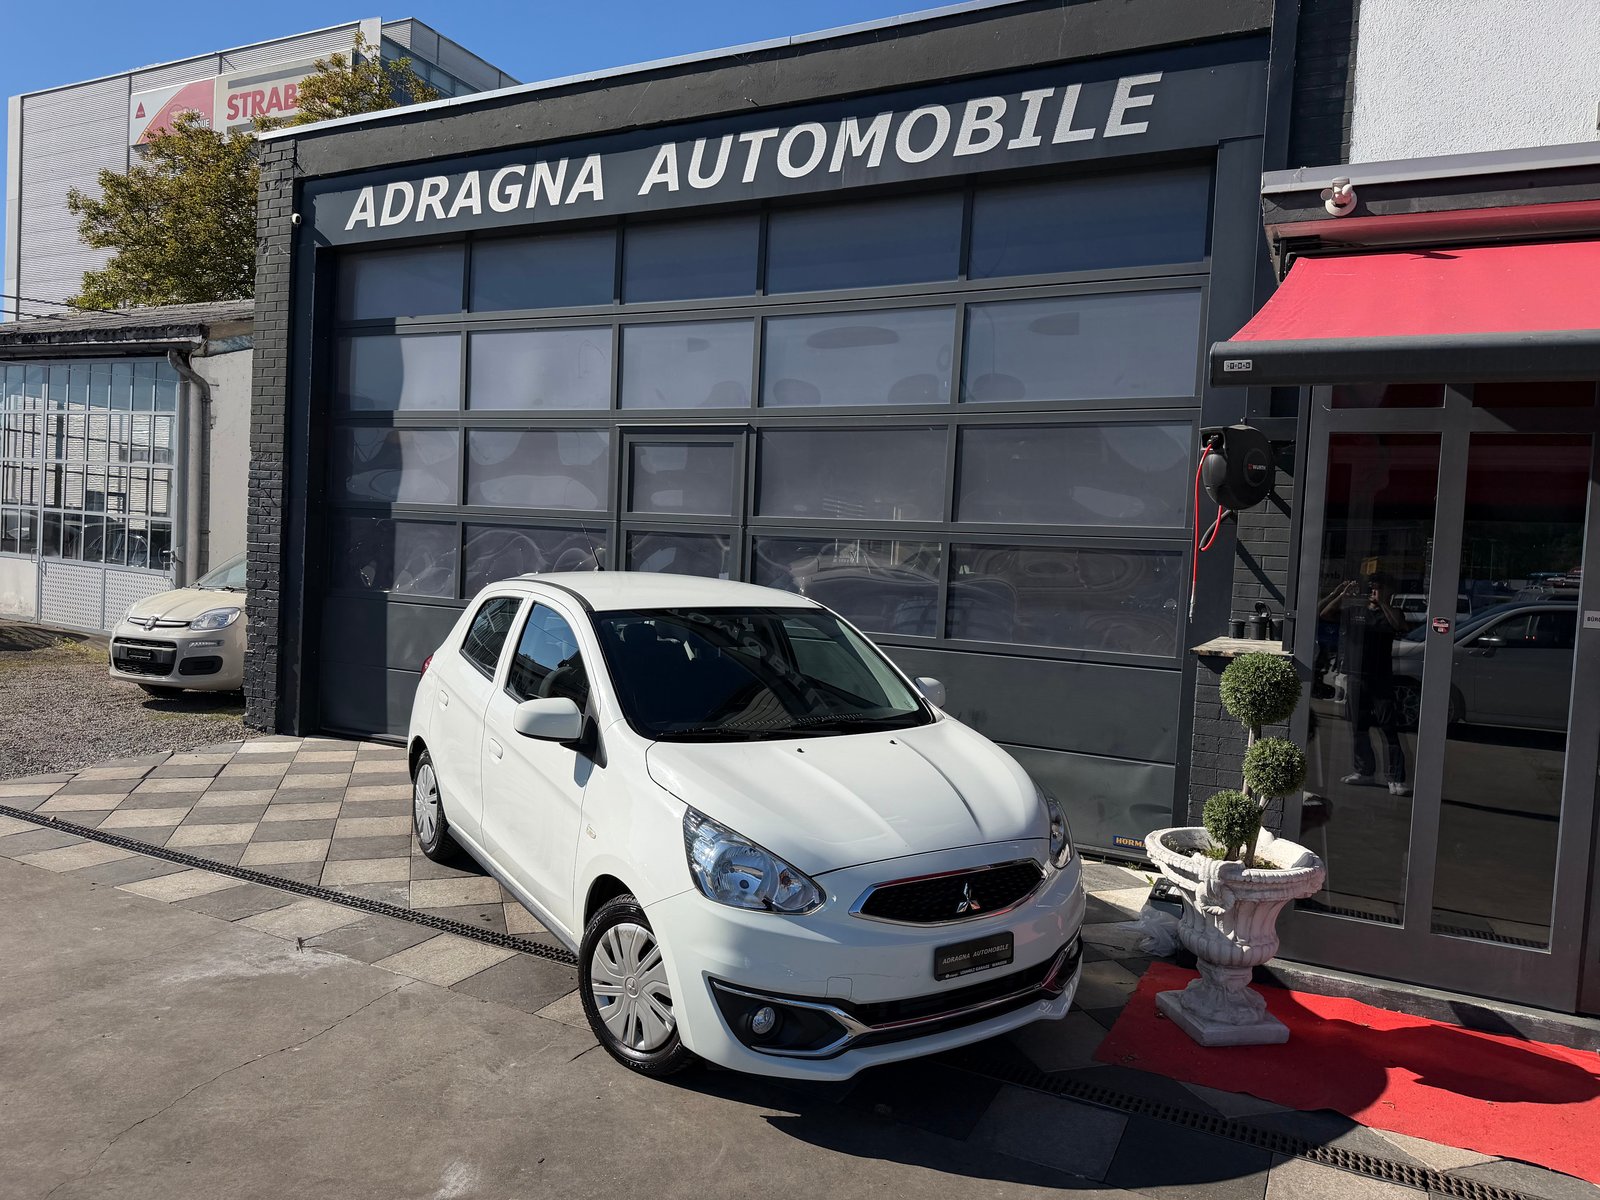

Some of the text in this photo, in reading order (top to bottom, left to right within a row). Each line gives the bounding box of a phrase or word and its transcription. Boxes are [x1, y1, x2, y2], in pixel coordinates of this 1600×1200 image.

[226, 83, 298, 121] STRAB
[344, 71, 1163, 231] ADRAGNA AUTOMOBILE
[942, 944, 1009, 964] ADRAGNA AUTOMOBILE
